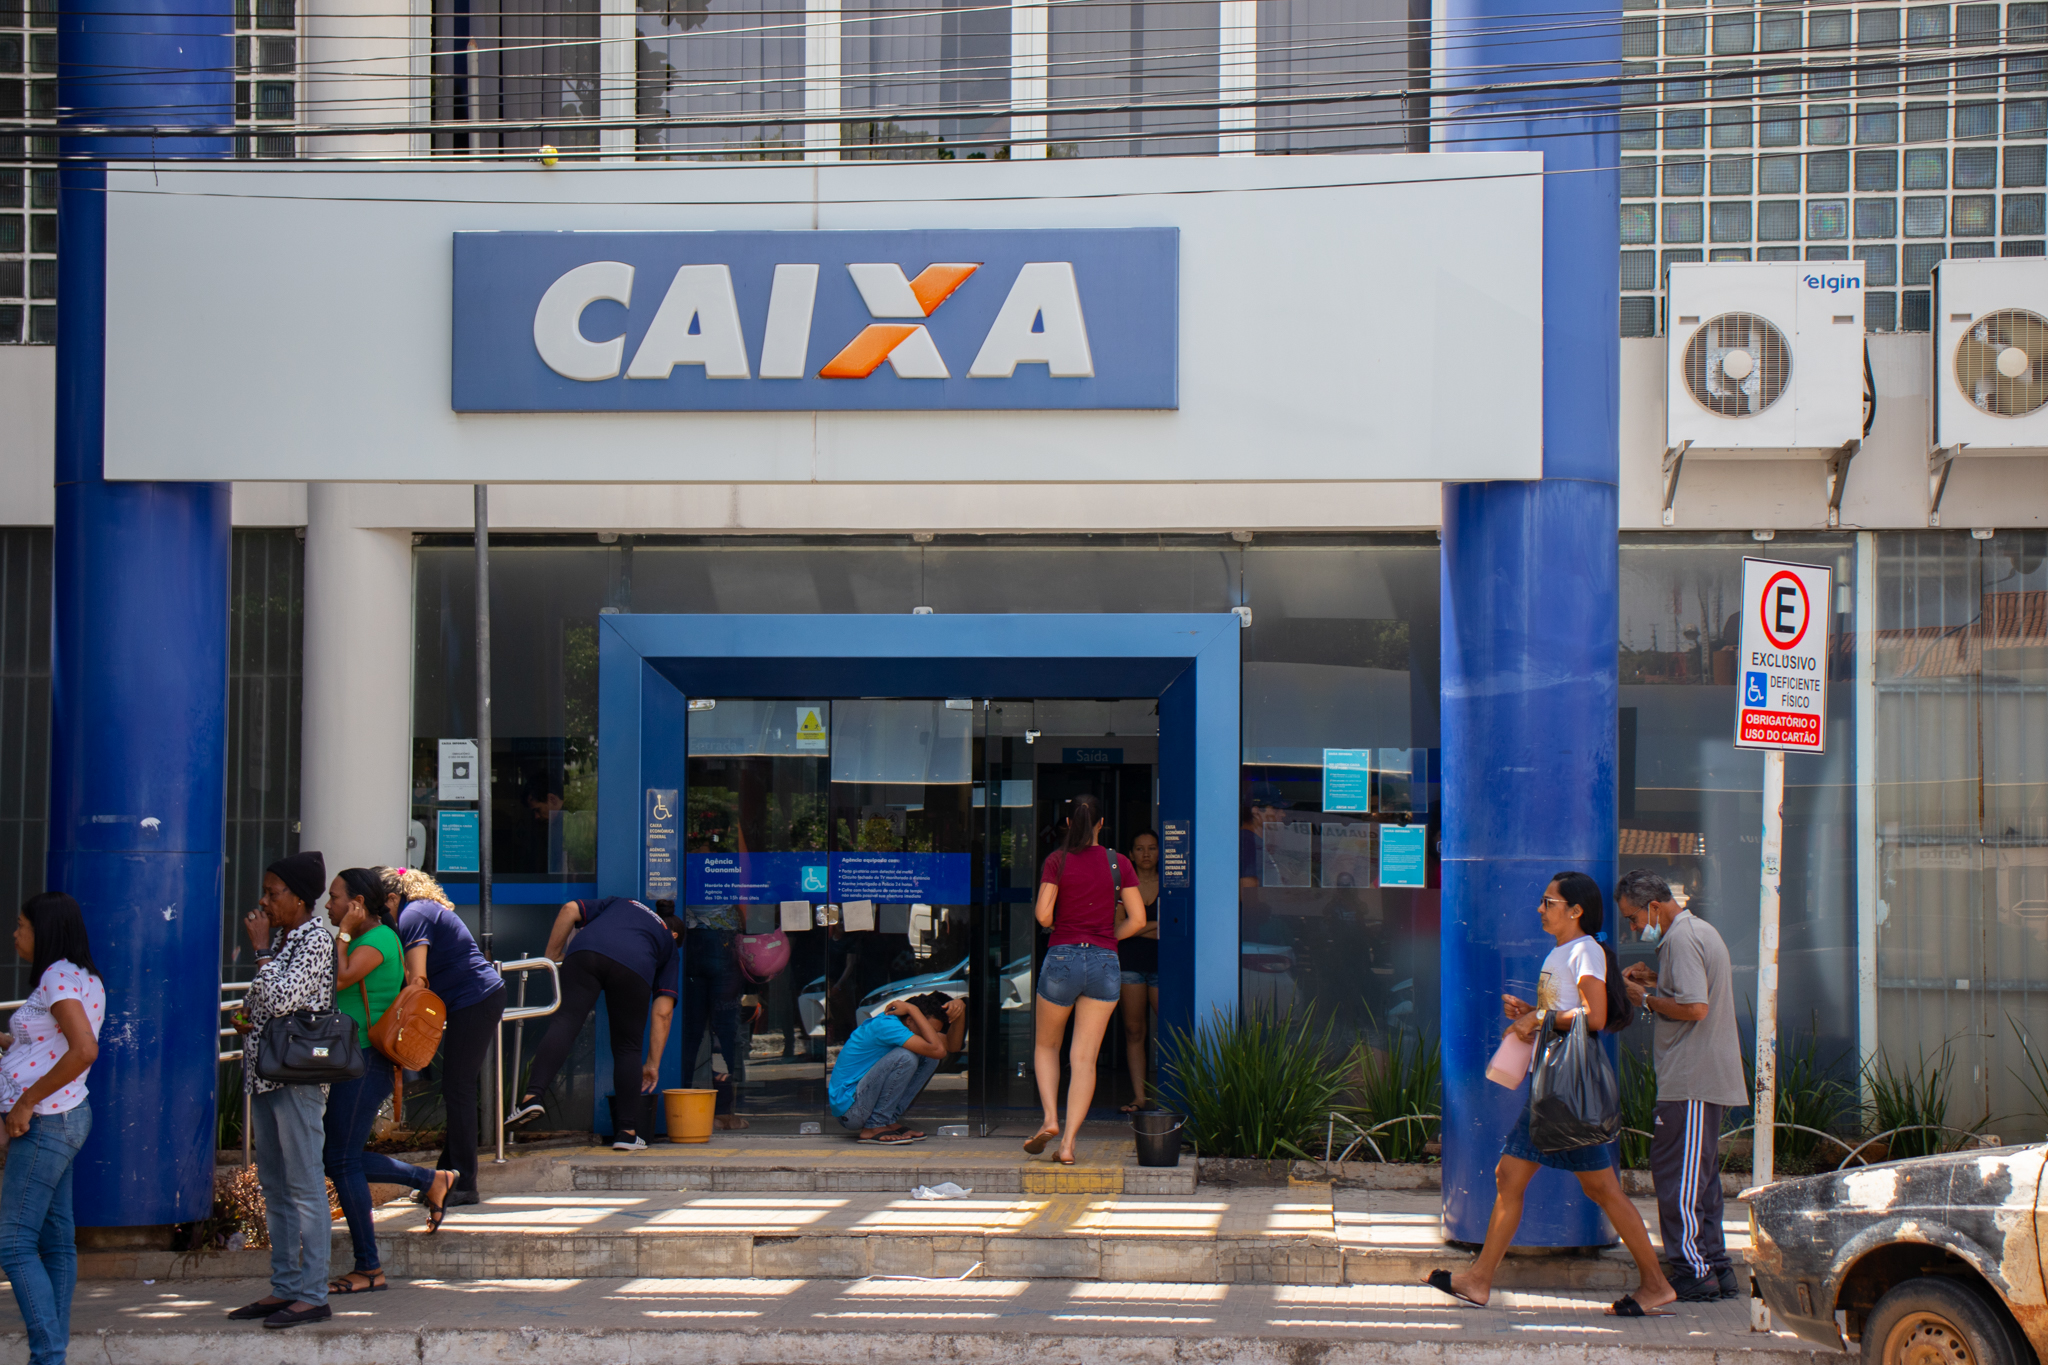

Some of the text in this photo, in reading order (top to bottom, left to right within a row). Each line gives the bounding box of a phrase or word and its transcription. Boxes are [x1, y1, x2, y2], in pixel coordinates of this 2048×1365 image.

[1807, 274, 1860, 293] elgin
[532, 260, 1095, 382] CAIXA
[1775, 586, 1796, 634] E
[1752, 651, 1816, 671] EXCLUSIVO
[1770, 675, 1820, 692] DEFICIENTE
[1782, 692, 1810, 708] FÍSICO
[1746, 714, 1816, 729] OBRIGATÓRIO O
[1745, 728, 1816, 744] USO DO CARTÃO
[1076, 750, 1108, 762] Saída
